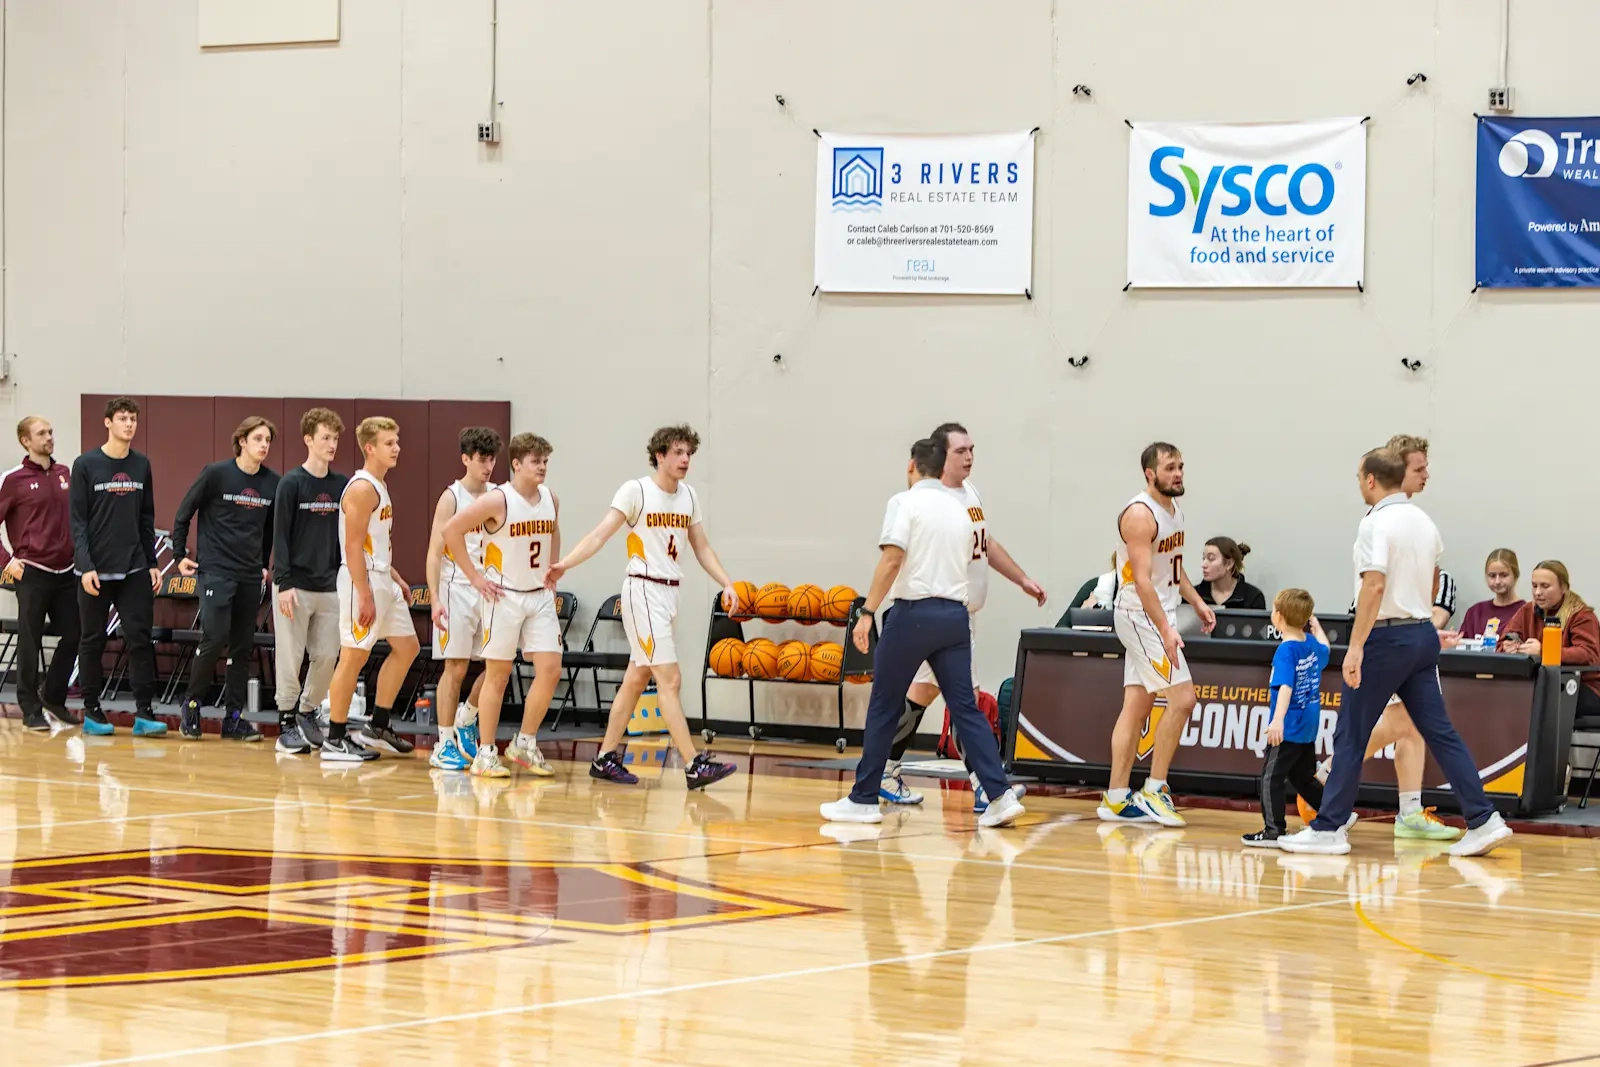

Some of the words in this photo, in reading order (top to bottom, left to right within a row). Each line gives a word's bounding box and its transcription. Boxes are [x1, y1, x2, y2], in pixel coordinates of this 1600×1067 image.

[891, 163, 902, 184] 3
[921, 162, 1018, 185] RIVERS
[1563, 169, 1599, 180] WEAL
[891, 192, 923, 203] REAL
[928, 191, 976, 203] ESTATE
[982, 191, 1018, 203] TEAM
[847, 224, 876, 233] Contact
[877, 224, 899, 233] Caleb
[900, 224, 929, 233] Carlson
[930, 225, 938, 233] at
[940, 224, 994, 234] 701-520-8569
[1211, 226, 1228, 242] At
[1232, 225, 1260, 242] the
[1265, 225, 1311, 242] heart
[1316, 224, 1335, 242] of
[1528, 222, 1567, 232] Powered
[1569, 222, 1579, 234] by
[857, 236, 998, 248] caleb@threeriversrealestateteam.com
[1190, 246, 1231, 264] food
[1236, 246, 1267, 264] and
[1271, 246, 1335, 264] service
[529, 541, 542, 569] 2
[667, 534, 678, 561] 4
